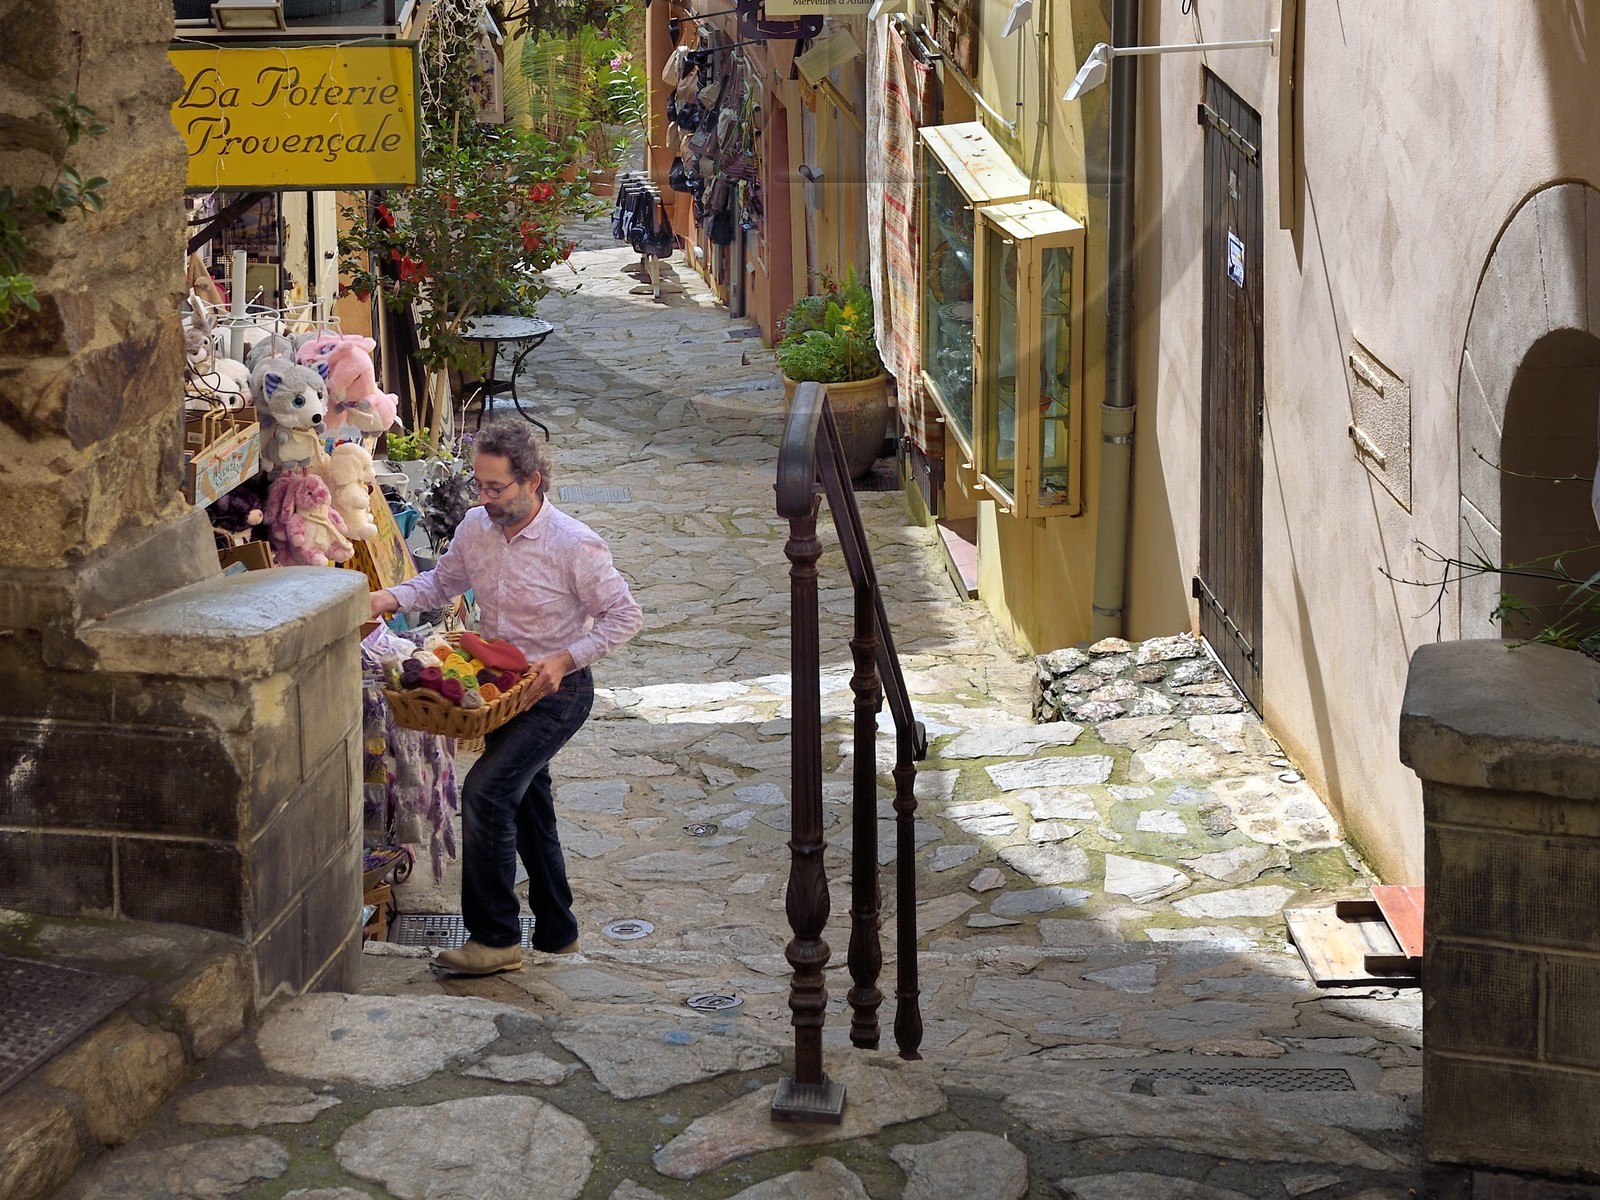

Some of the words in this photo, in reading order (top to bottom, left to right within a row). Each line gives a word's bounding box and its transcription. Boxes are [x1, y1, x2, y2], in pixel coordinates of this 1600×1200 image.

[178, 67, 239, 108] La
[252, 66, 399, 107] Poterie
[187, 113, 402, 163] Provençale
